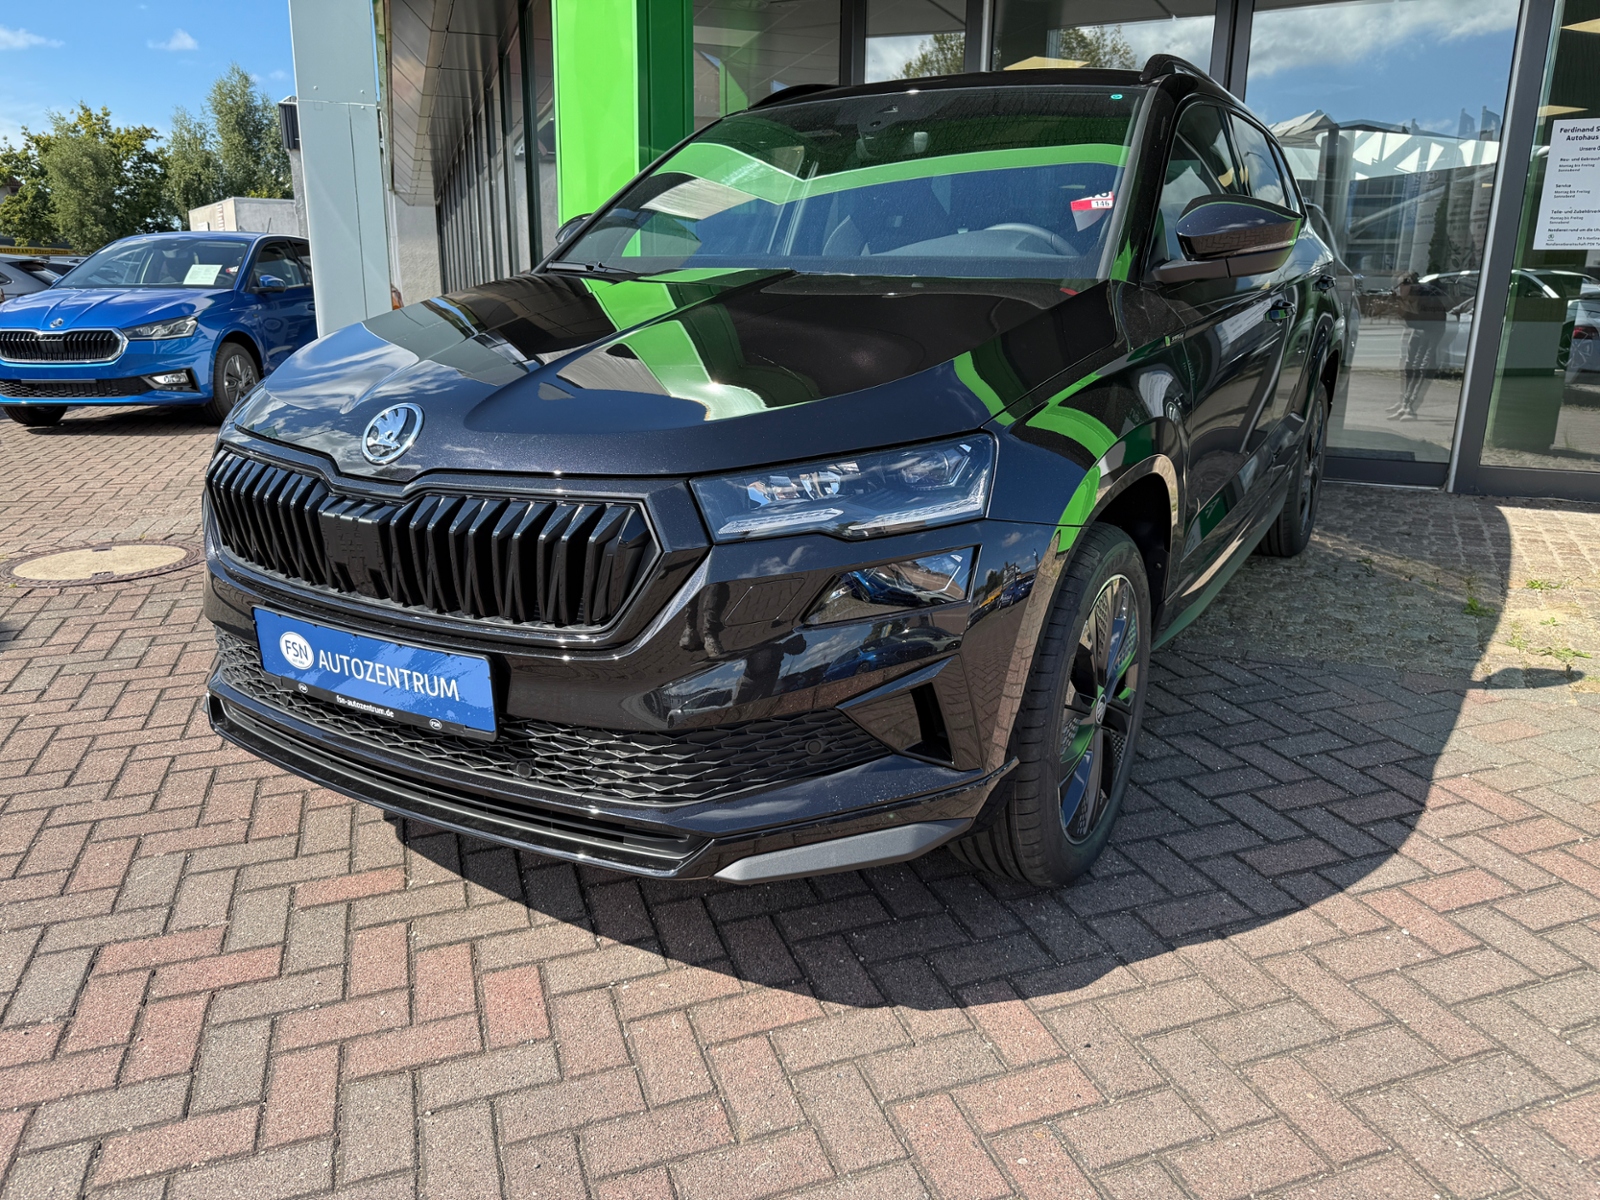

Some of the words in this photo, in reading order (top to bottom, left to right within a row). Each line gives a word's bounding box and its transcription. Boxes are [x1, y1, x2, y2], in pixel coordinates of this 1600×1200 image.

[285, 639, 309, 661] FSN
[318, 649, 460, 702] AUTOZENTRUM
[336, 695, 394, 718] fsn-autozentrum.de
